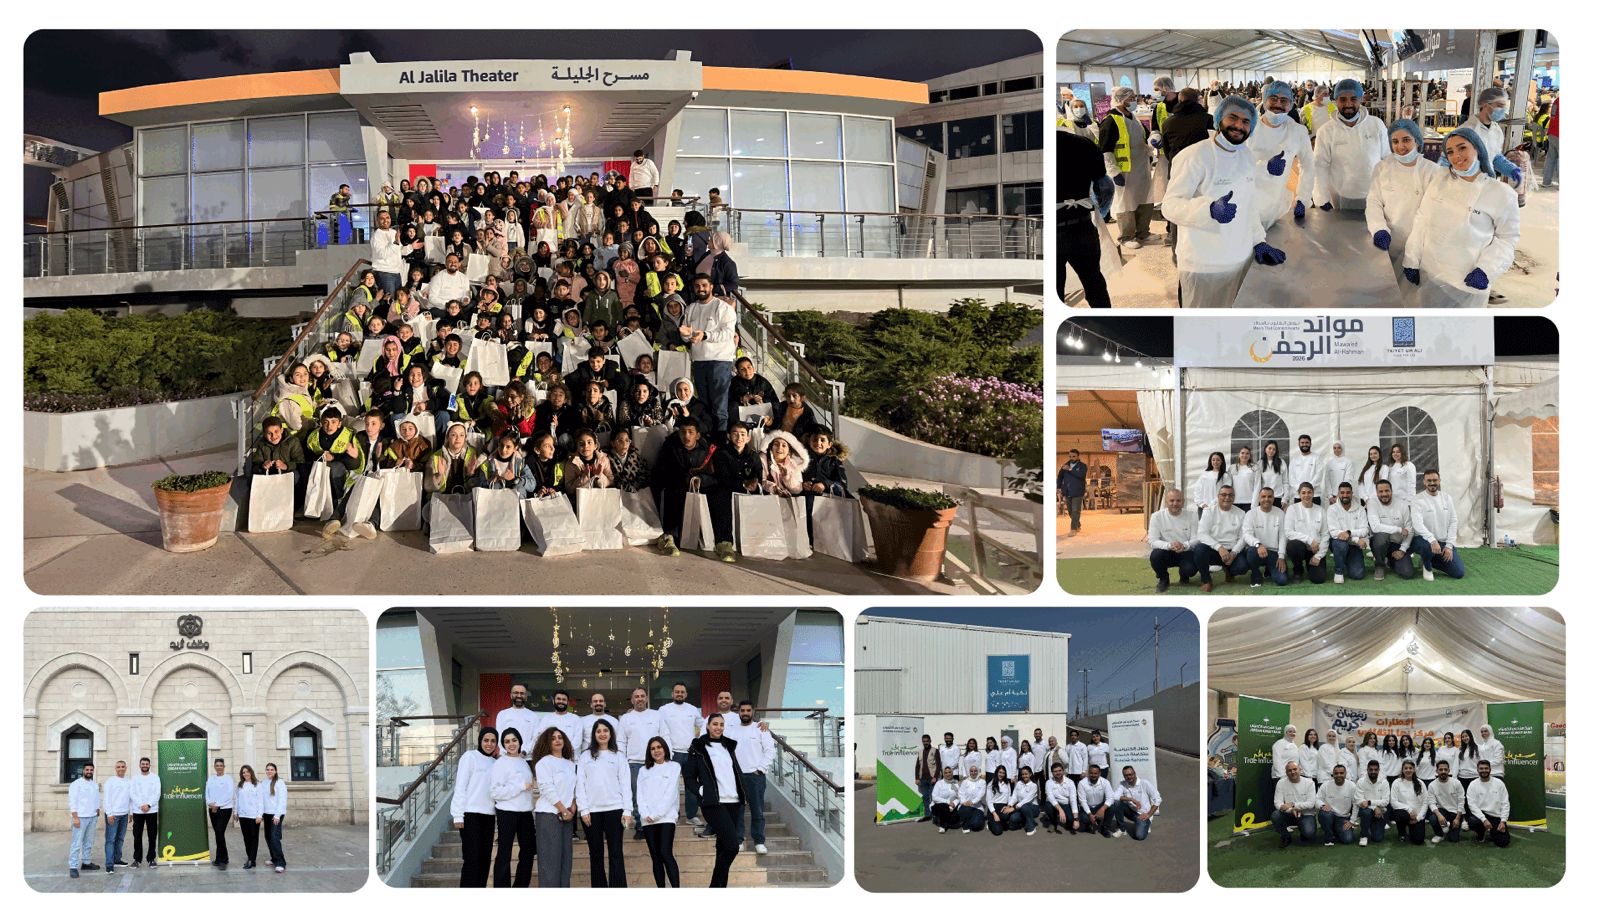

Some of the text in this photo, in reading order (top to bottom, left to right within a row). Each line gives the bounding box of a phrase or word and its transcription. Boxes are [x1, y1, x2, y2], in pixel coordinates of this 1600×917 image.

[399, 69, 519, 84] Al Jalila Theater
[551, 66, 650, 86] مسرح الجليلة
